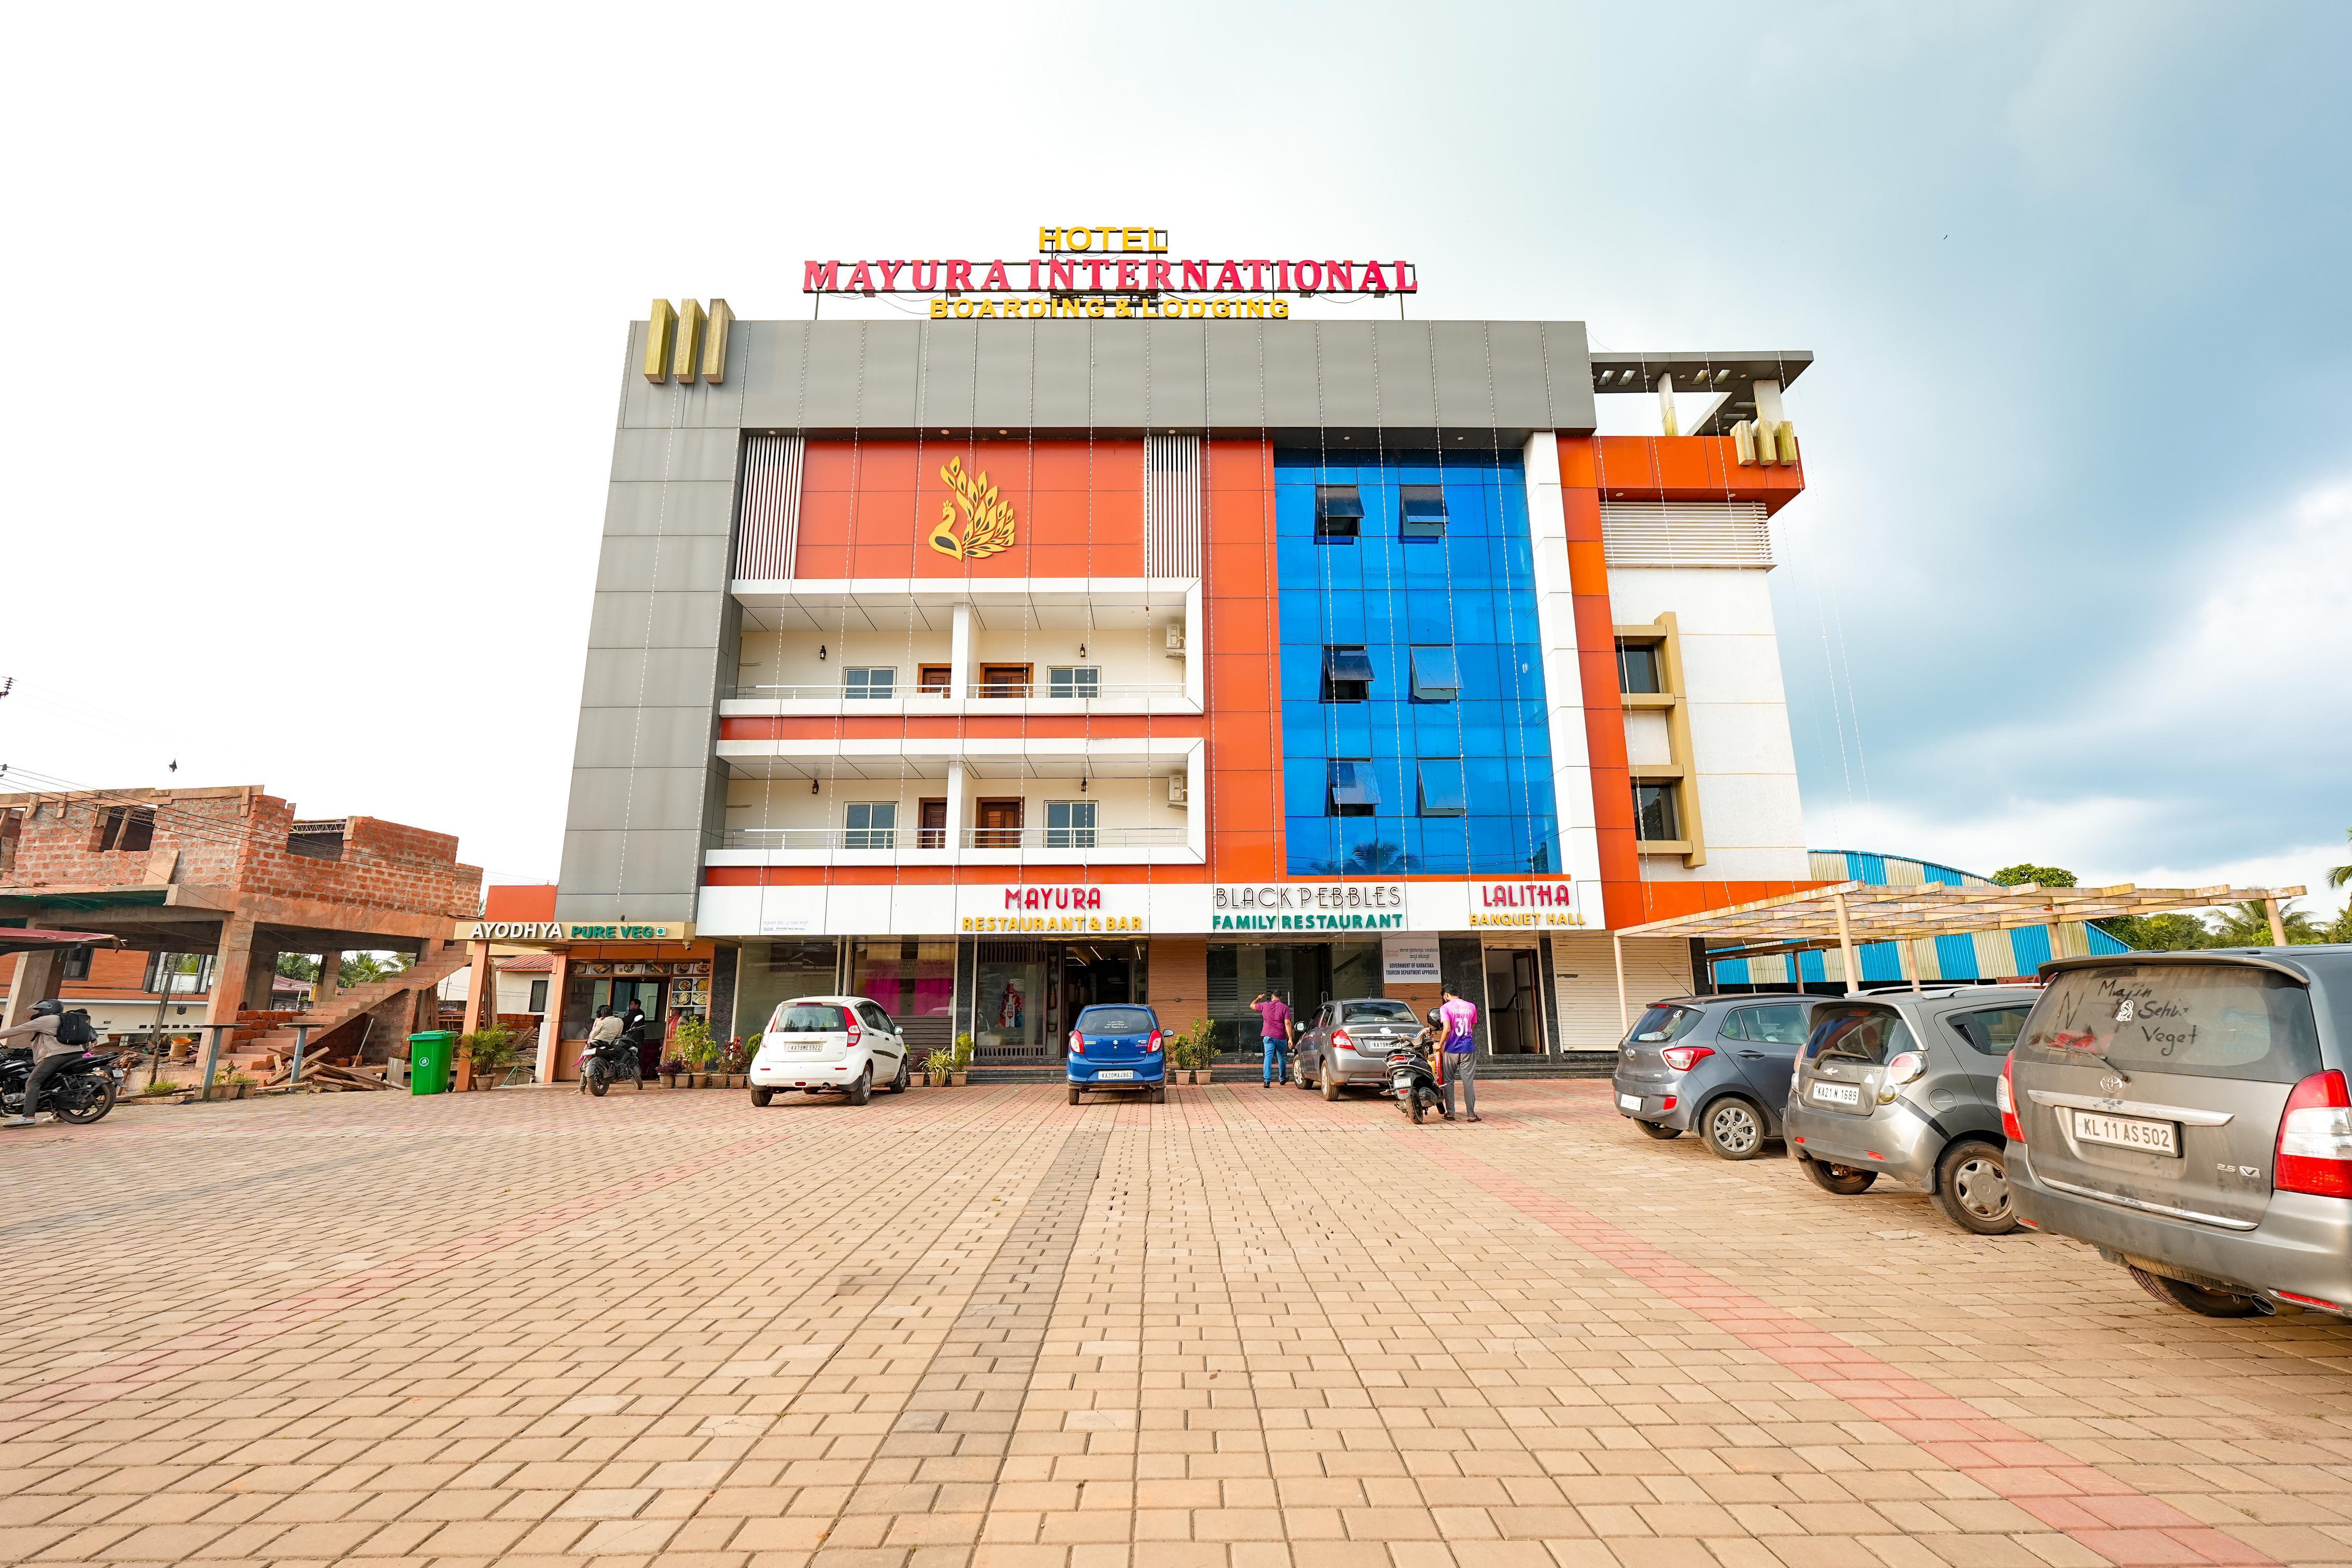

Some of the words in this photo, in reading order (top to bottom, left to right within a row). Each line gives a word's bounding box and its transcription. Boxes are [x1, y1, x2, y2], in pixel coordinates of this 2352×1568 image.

[1039, 226, 1168, 252] HOTEL
[803, 259, 1011, 293] MAYURA
[1028, 259, 1417, 293] INTERNATIONAL
[930, 298, 1105, 319] BOARDING
[1114, 298, 1133, 318] &
[1142, 298, 1288, 319] LODGING
[1005, 887, 1101, 909] MAYURA
[1213, 887, 1294, 908] BLACK
[1297, 886, 1401, 908] PEBBLES
[1482, 884, 1570, 907] LALITHA
[962, 916, 1085, 931] RESTAURANT
[1089, 917, 1101, 931] &
[1105, 916, 1143, 931] BAR
[1213, 915, 1277, 929] FAMILY
[1282, 914, 1403, 929] RESTAURANT
[1469, 913, 1541, 926] BANQUET
[1546, 913, 1586, 925] HALL
[470, 923, 564, 939] AYODHYA
[571, 925, 616, 939] PURE
[620, 925, 654, 939] VEG
[1455, 1017, 1468, 1036] 31
[1817, 1087, 1832, 1098] KA21
[1841, 1089, 1857, 1101] 1689
[2084, 1118, 2100, 1136] KL
[2104, 1121, 2118, 1139] 11
[2124, 1124, 2139, 1143] AS
[2142, 1126, 2170, 1148] 502
